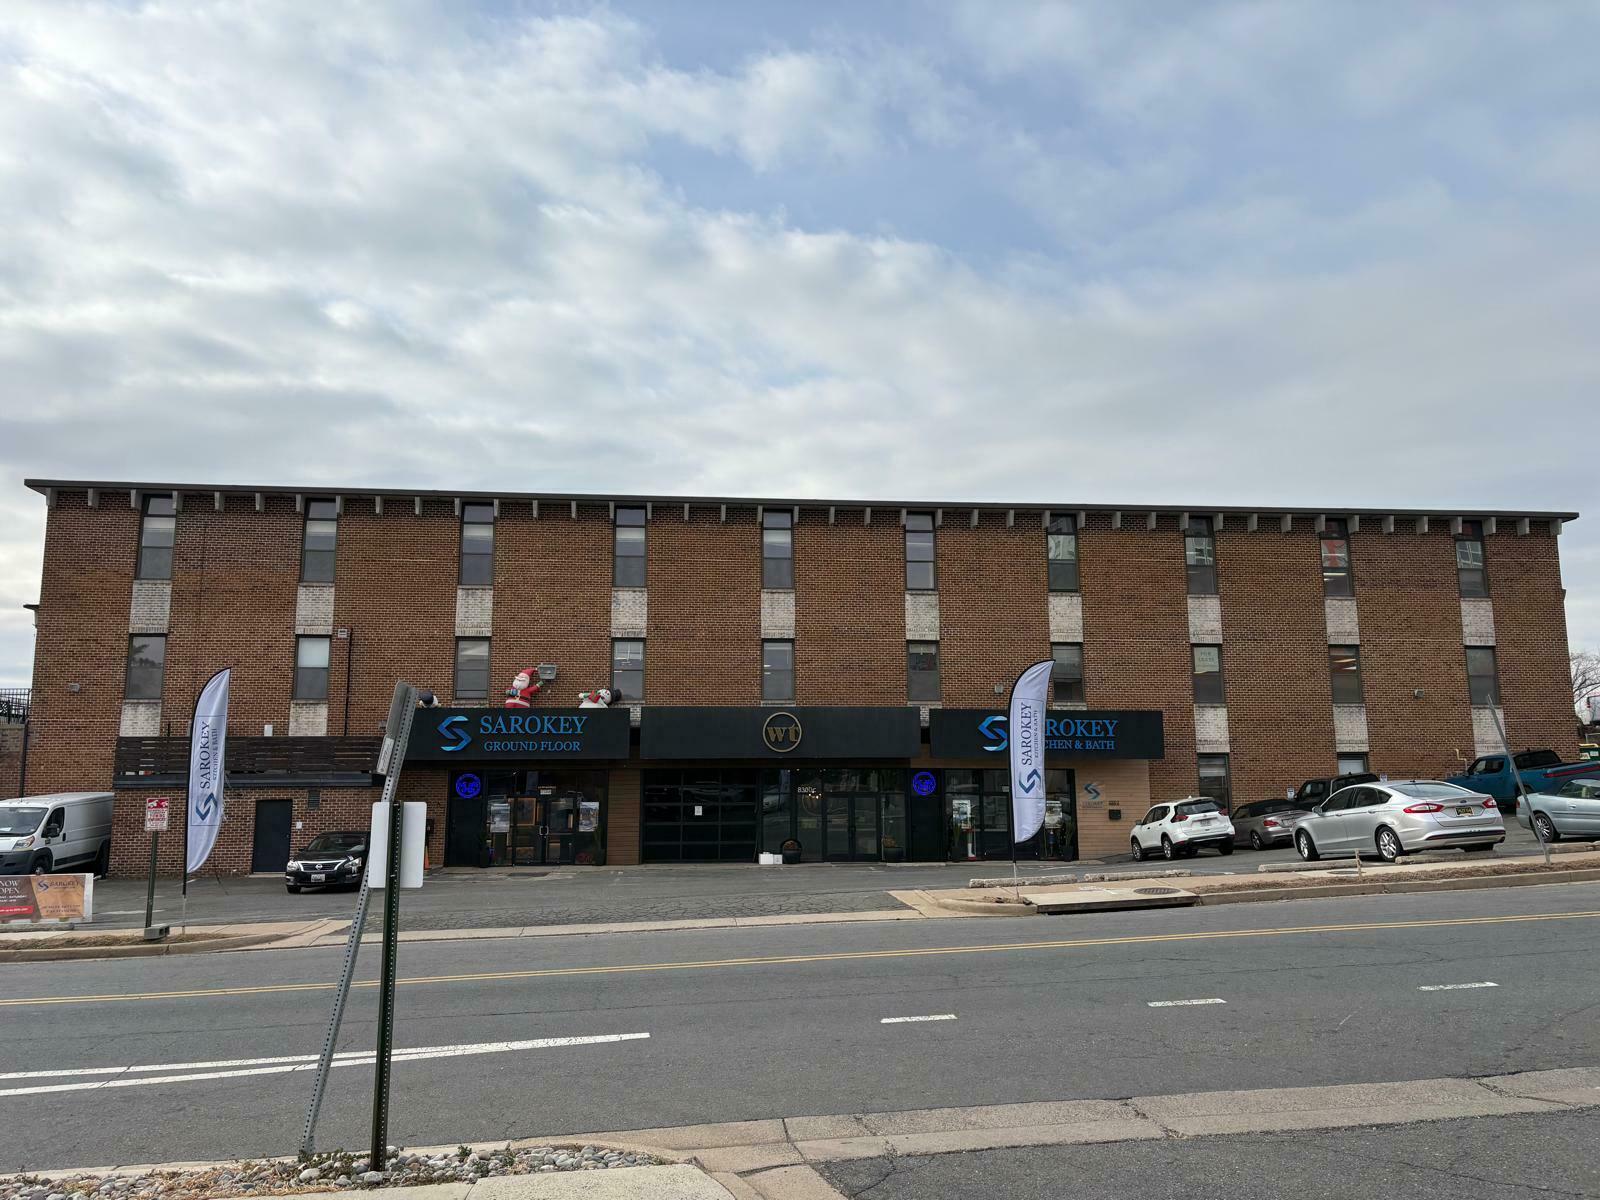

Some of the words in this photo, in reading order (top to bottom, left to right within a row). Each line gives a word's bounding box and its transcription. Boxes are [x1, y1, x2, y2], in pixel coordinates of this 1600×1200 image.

[480, 715, 588, 734] SAROKEY
[1045, 719, 1119, 737] ROKEY
[1020, 702, 1032, 766] SAROKEY
[484, 741, 538, 751] GROUND
[541, 741, 581, 751] FLOOR
[1044, 740, 1073, 750] CHEN
[1074, 740, 1083, 750] &
[1086, 740, 1115, 750] BATH
[199, 721, 211, 789] SAROKEY
